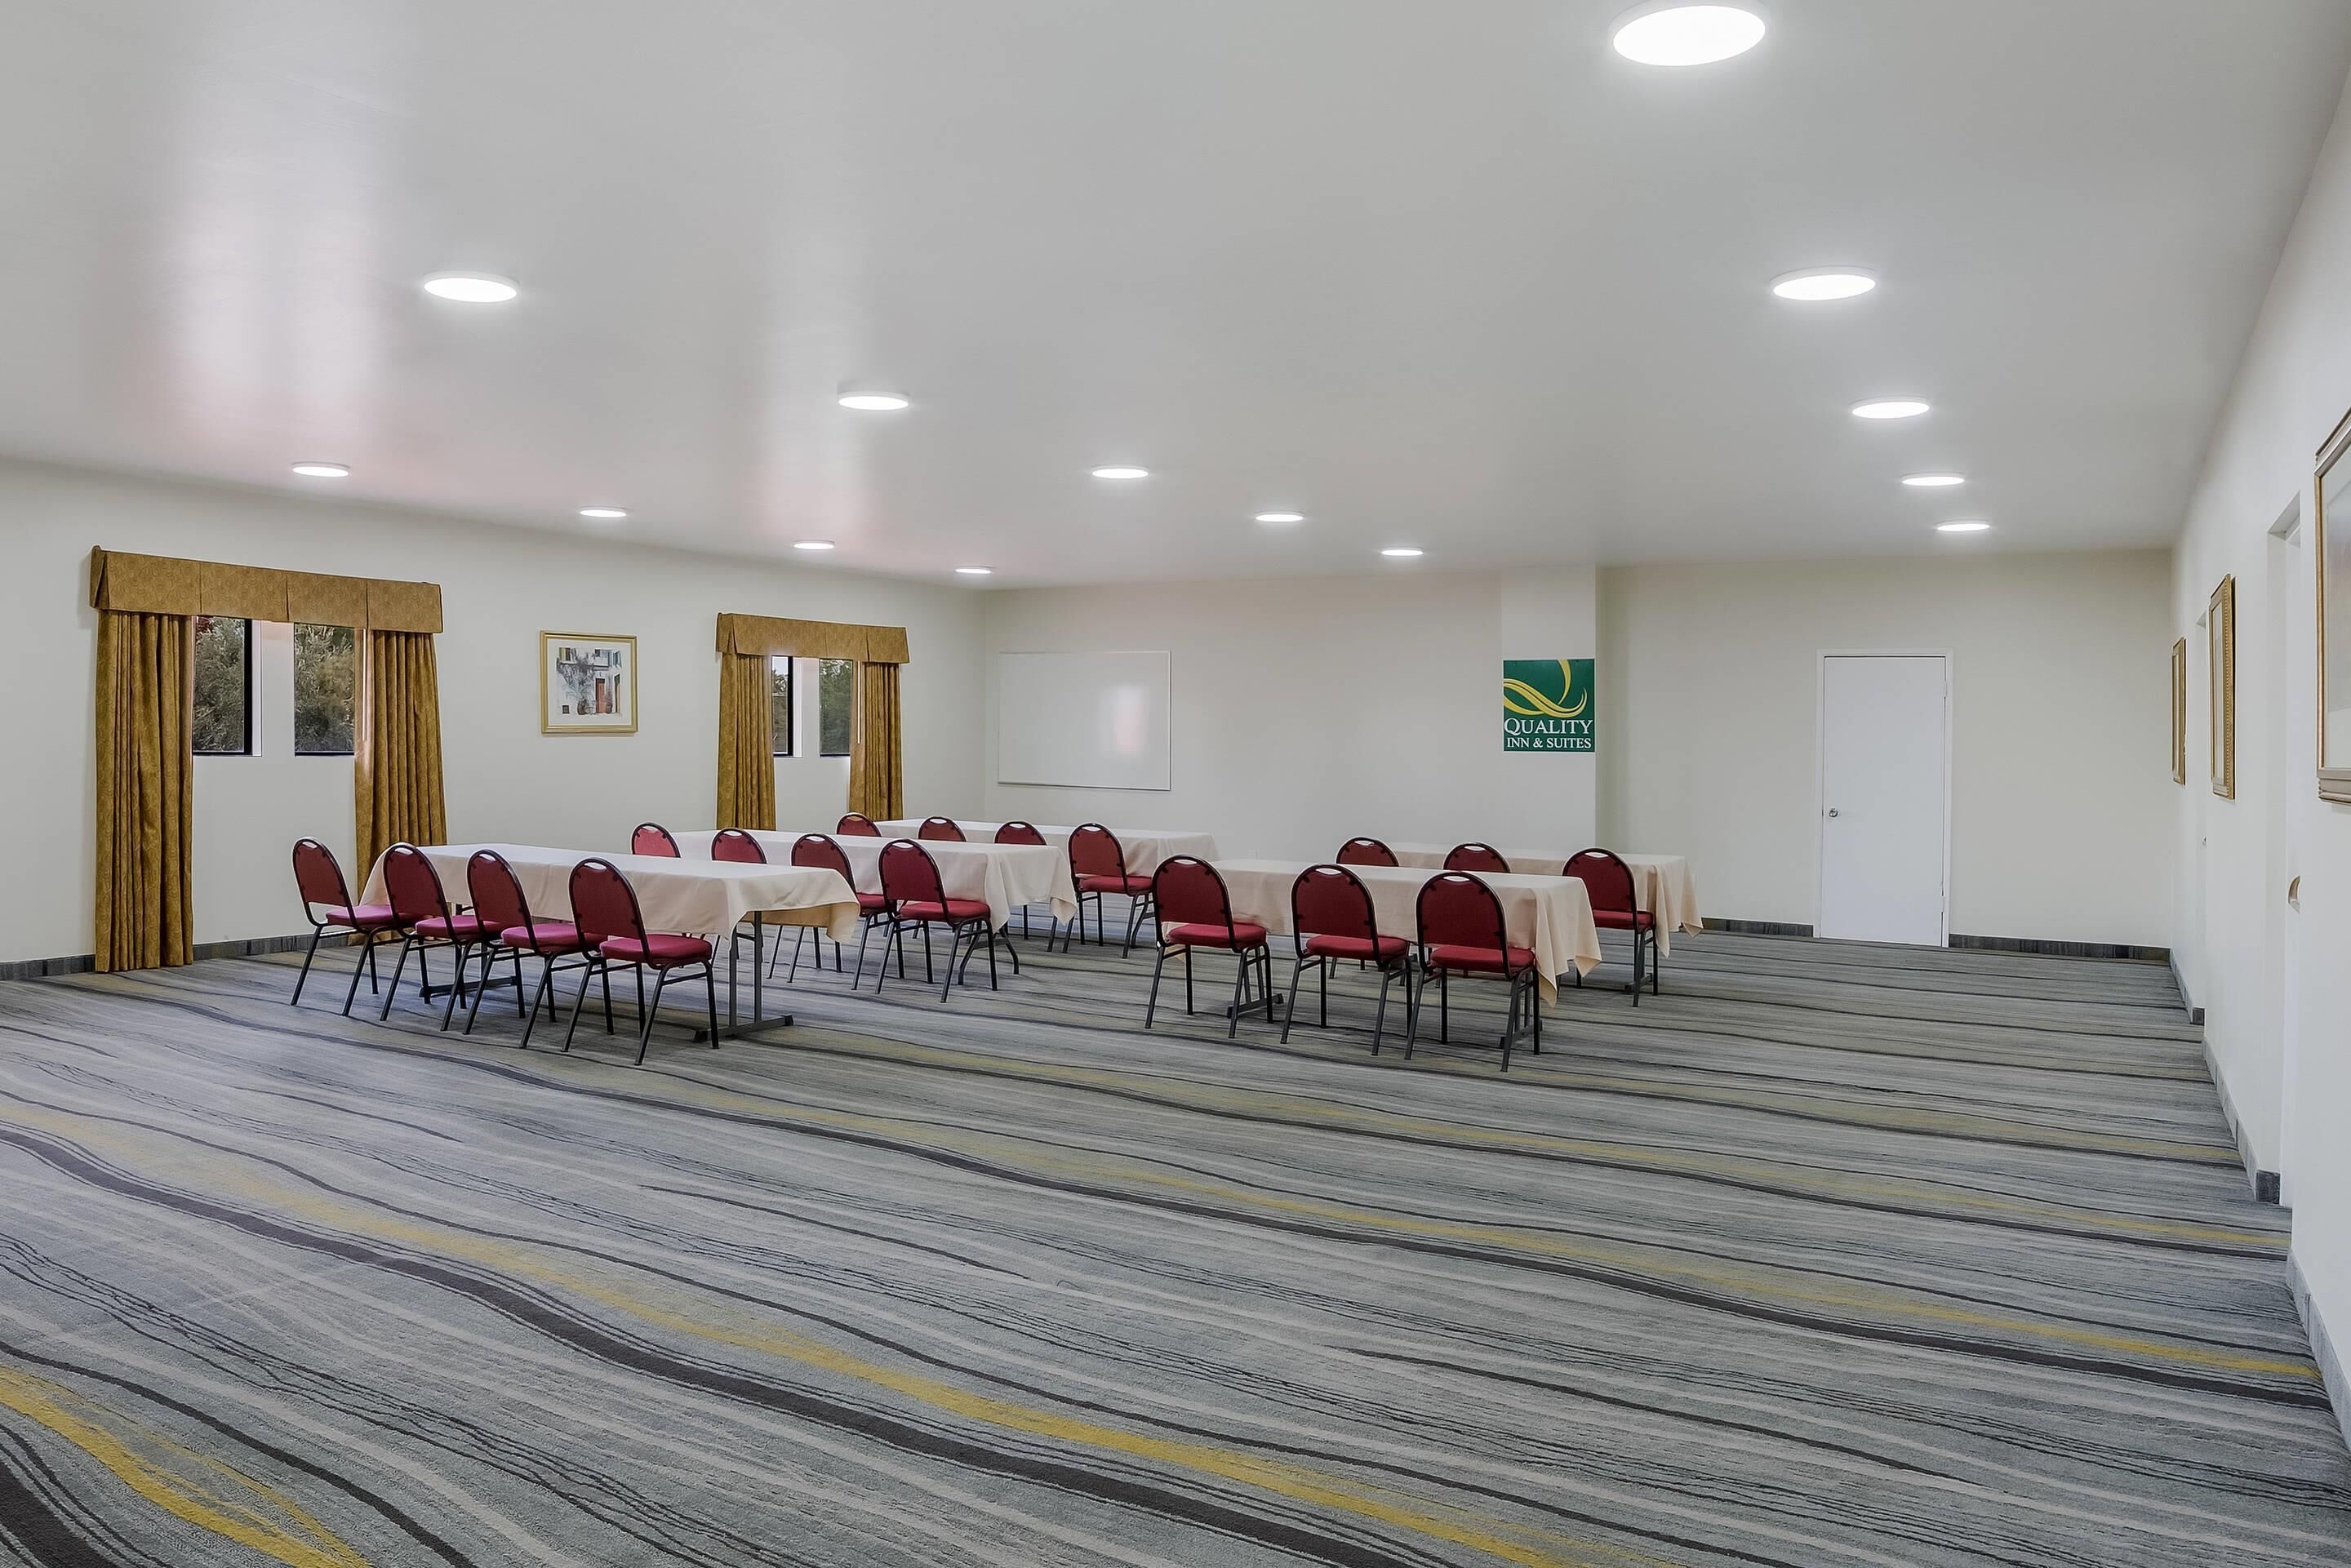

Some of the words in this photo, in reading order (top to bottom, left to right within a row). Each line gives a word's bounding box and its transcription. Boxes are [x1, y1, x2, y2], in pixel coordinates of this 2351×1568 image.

[1504, 717, 1593, 735] QUALITY
[1507, 737, 1530, 748] INN
[1533, 737, 1543, 748] &
[1546, 737, 1592, 748] SUITES
